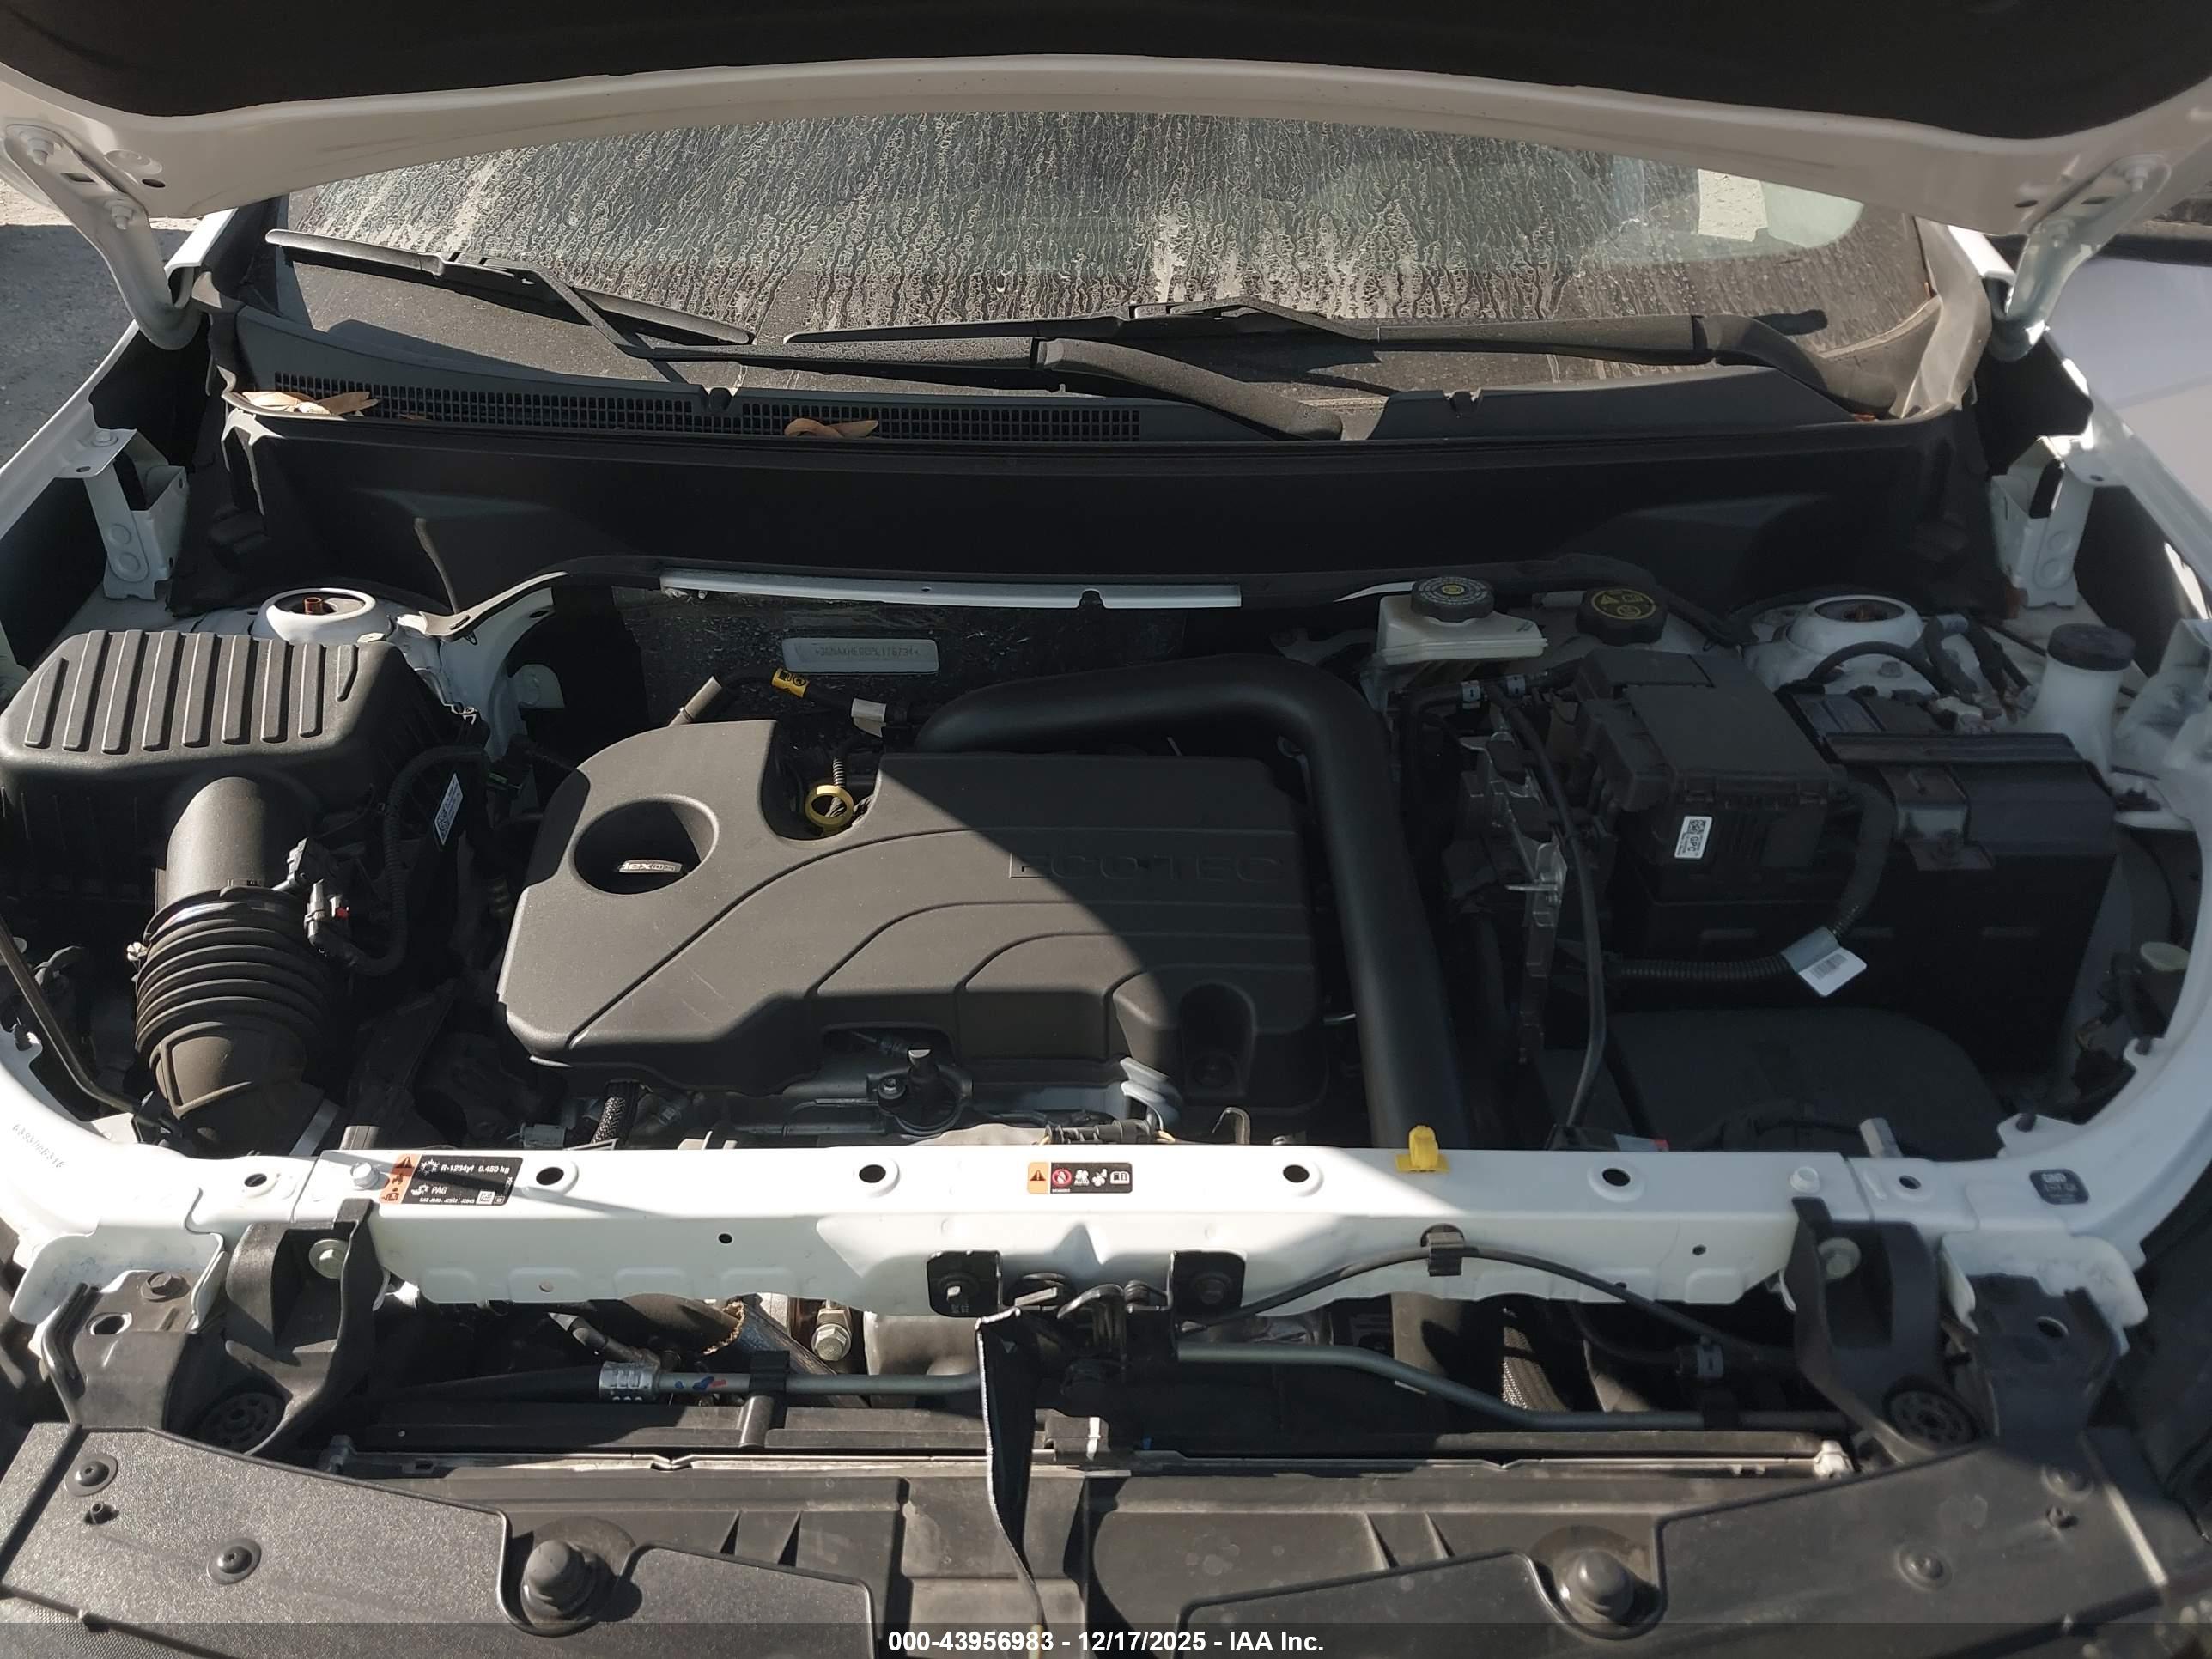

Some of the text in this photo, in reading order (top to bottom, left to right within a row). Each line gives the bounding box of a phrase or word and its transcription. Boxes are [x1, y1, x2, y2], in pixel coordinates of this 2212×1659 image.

[1009, 851, 1283, 882] ECOTEC
[441, 1164, 474, 1173] R-1234yf
[500, 1166, 510, 1175] kg
[431, 1186, 447, 1194] PAG
